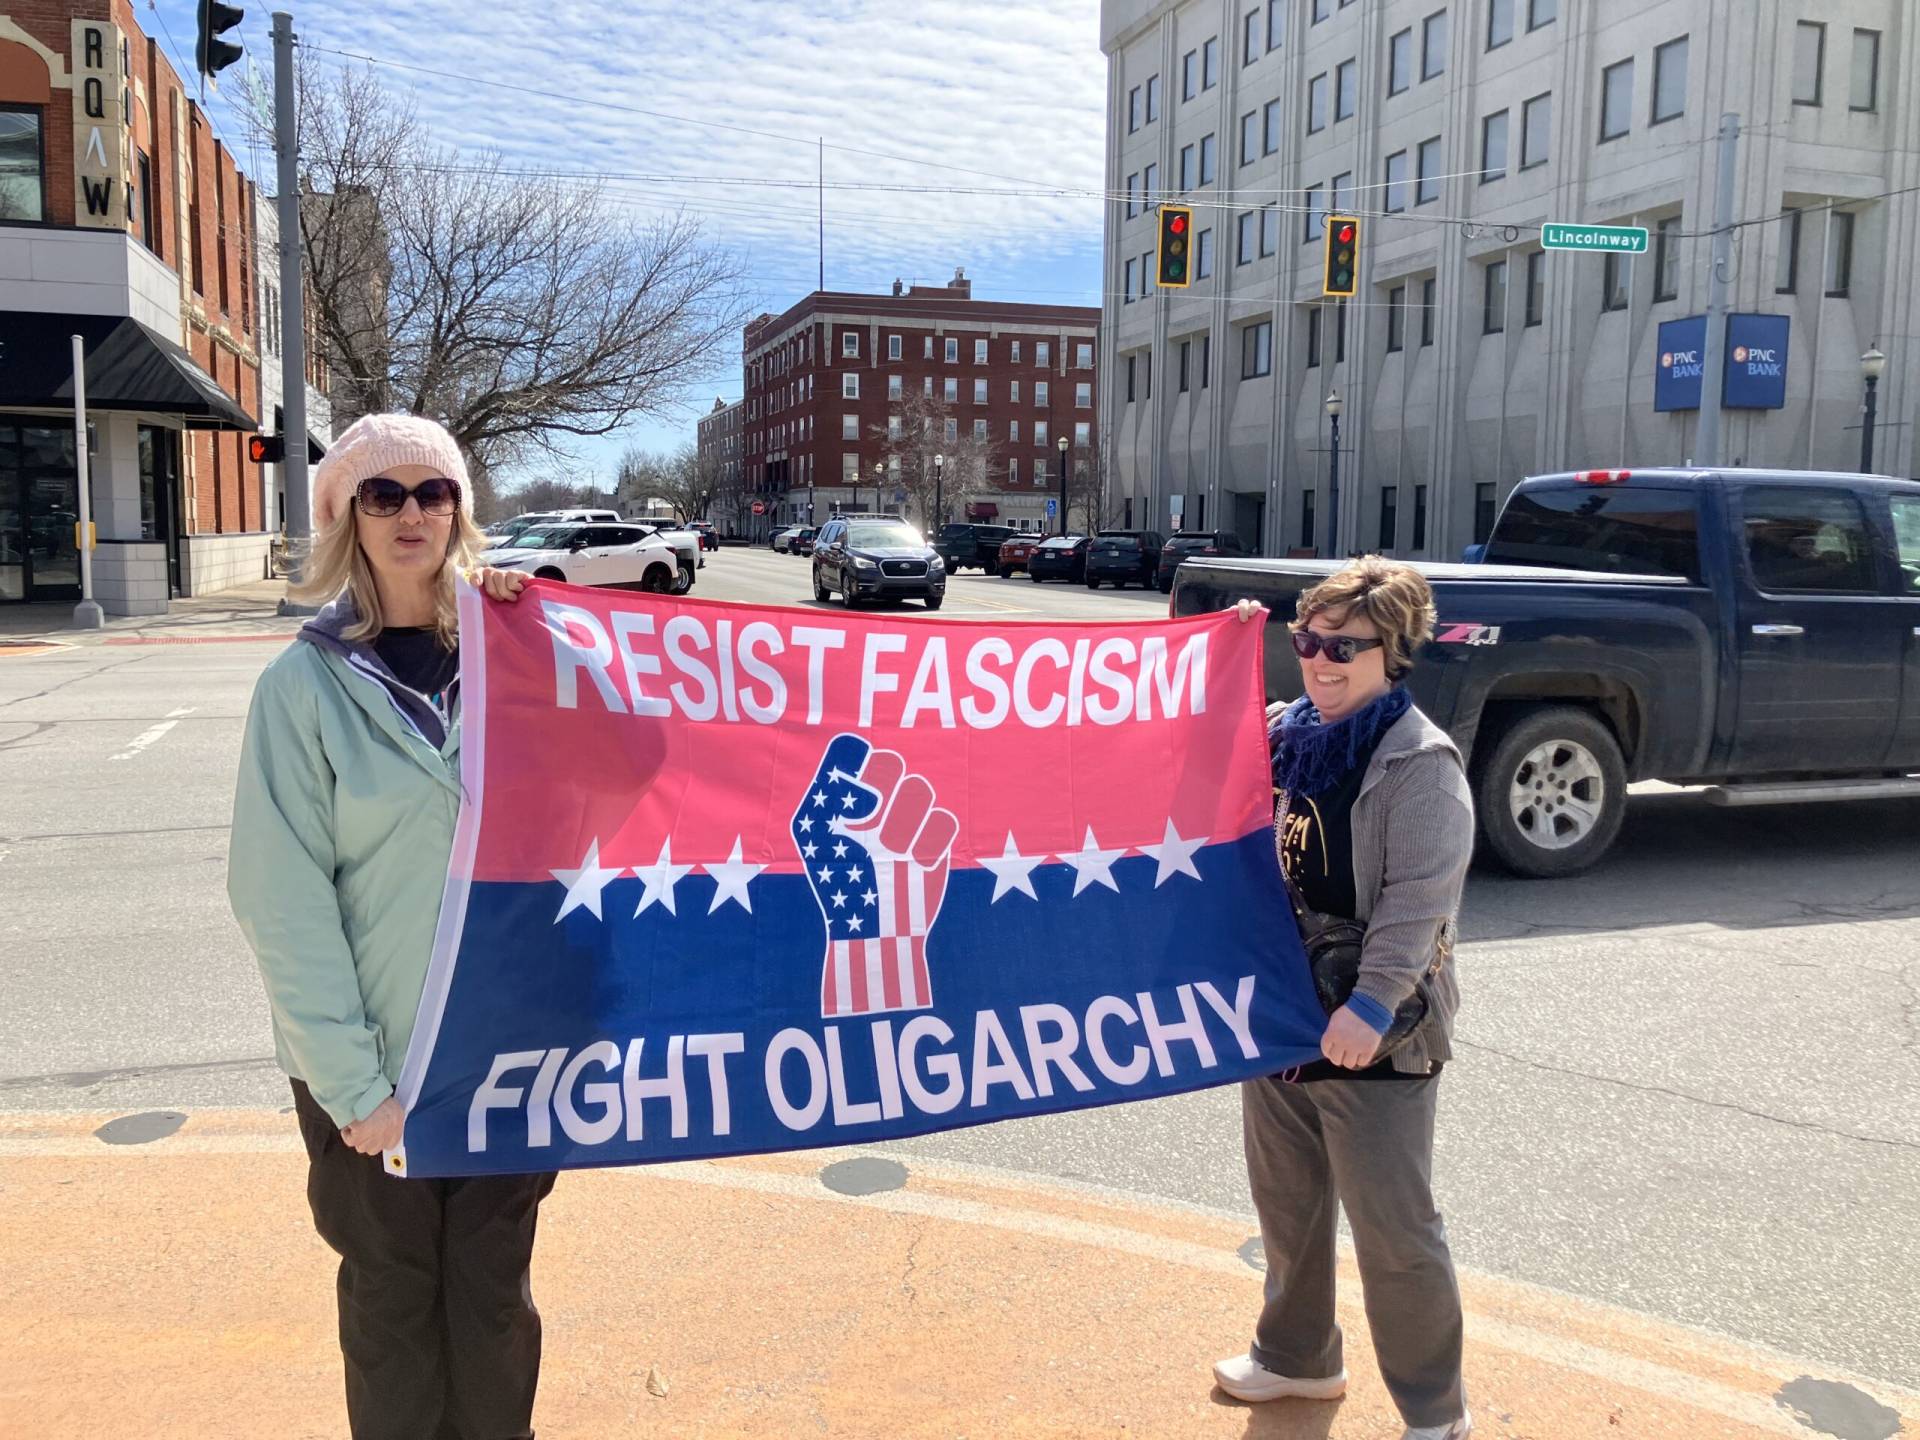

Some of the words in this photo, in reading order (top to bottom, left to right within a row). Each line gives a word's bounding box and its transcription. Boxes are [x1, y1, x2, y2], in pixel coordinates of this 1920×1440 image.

[1548, 229, 1641, 250] Lincolnway
[1672, 351, 1698, 365] PNC
[1748, 348, 1776, 362] PNC
[1672, 363, 1704, 379] BANK
[1747, 363, 1782, 376] BANK
[1436, 623, 1501, 642] Z71
[535, 599, 847, 725] RESIST
[857, 631, 1210, 730] FASCISM
[467, 1032, 745, 1153] FIGHT
[764, 974, 1261, 1132] OLIGARCHY
